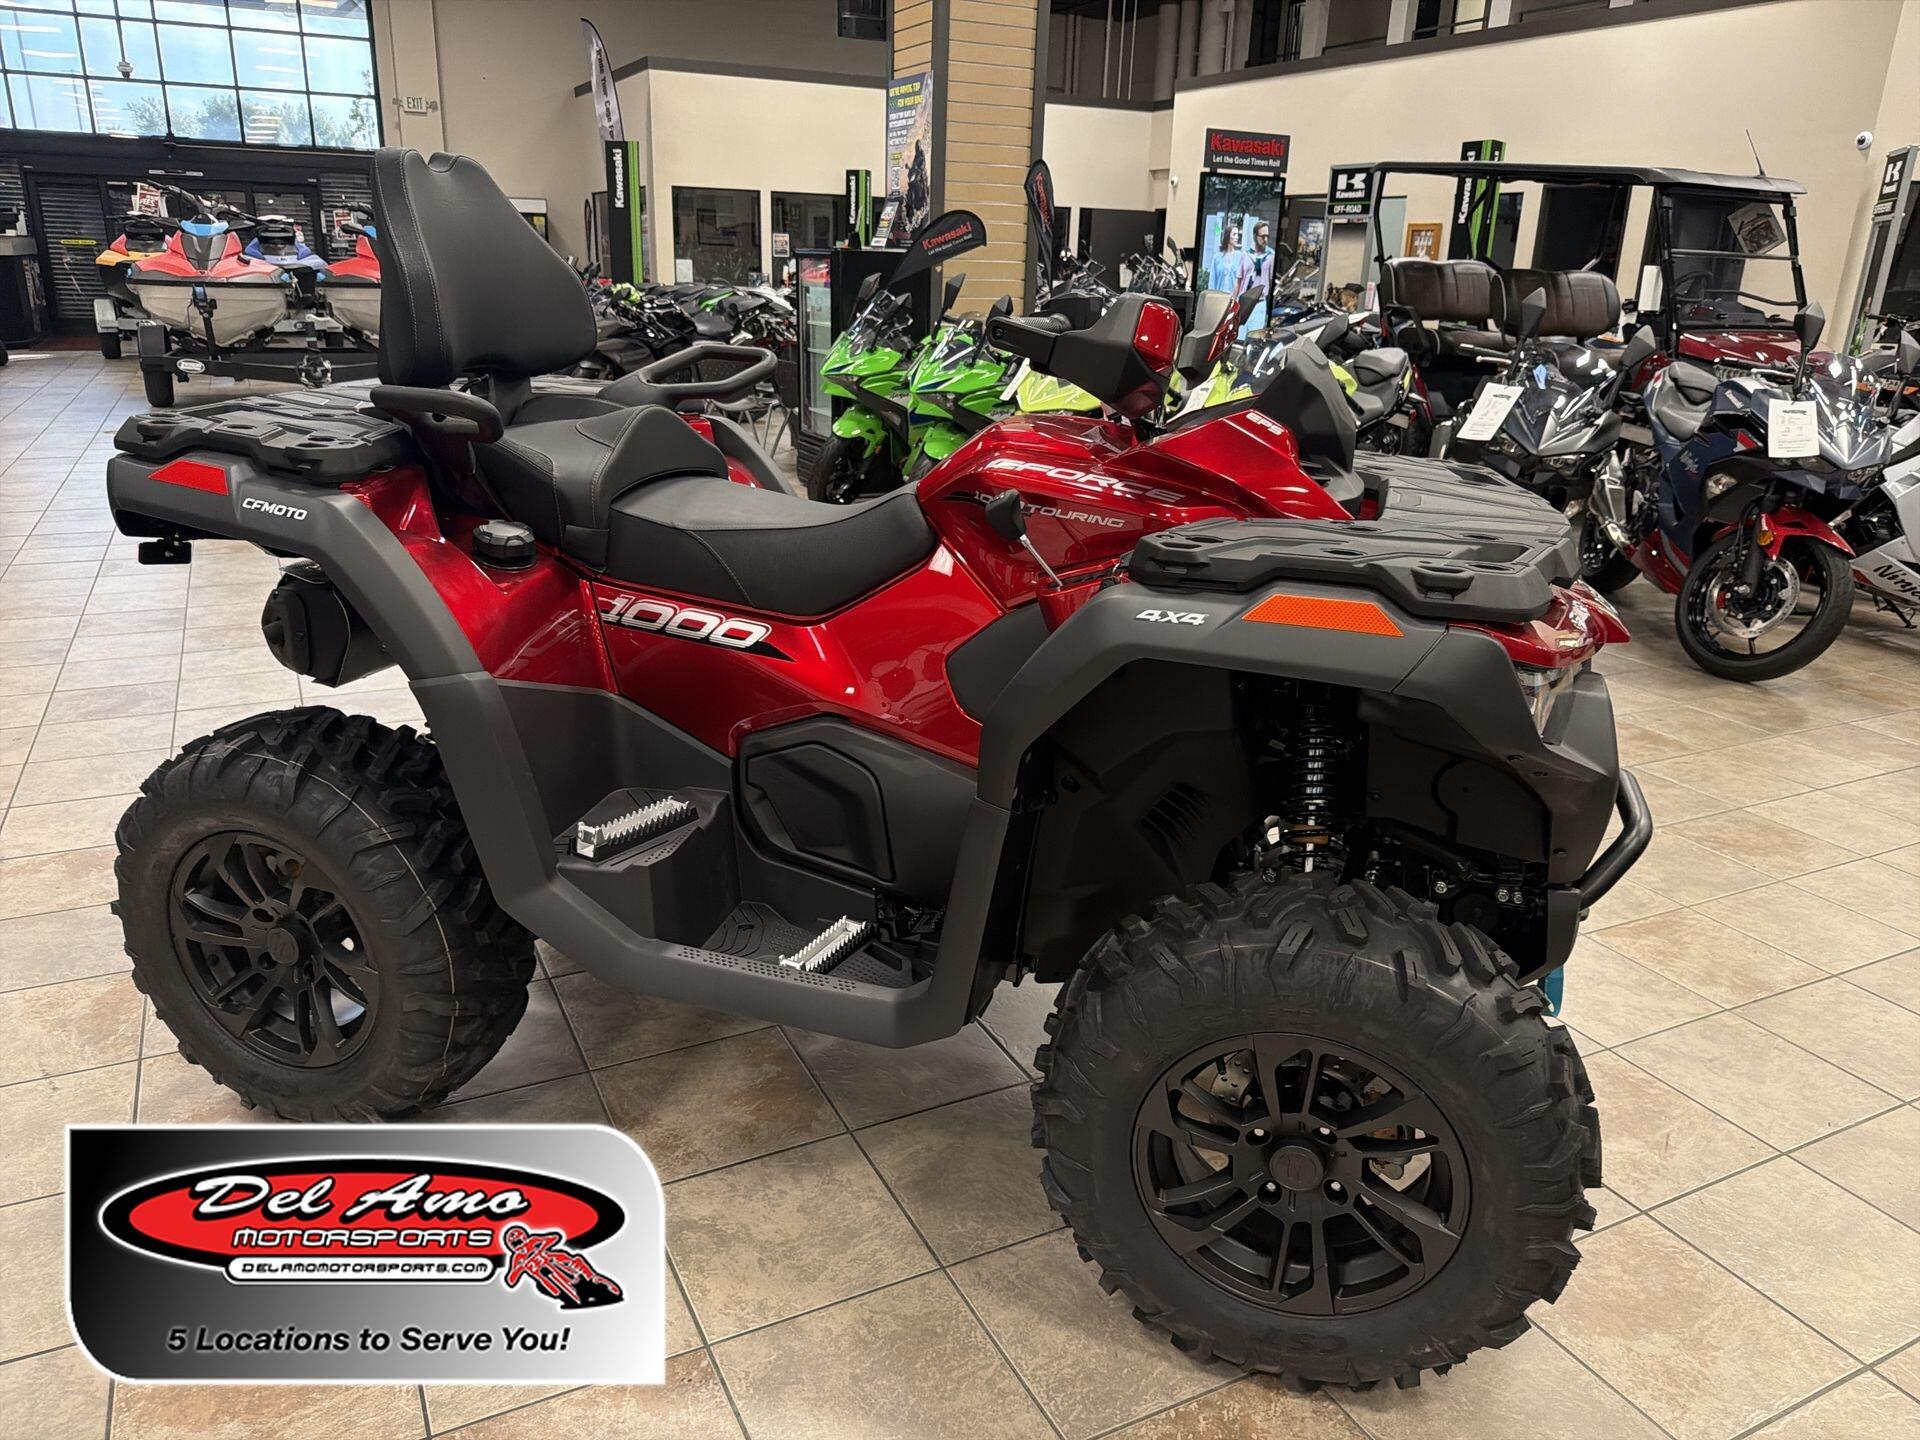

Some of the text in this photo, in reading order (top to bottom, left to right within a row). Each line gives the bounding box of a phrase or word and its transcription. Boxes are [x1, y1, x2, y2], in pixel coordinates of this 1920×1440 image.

[406, 96, 423, 110] EXIT
[1210, 133, 1285, 156] Kawasaki
[1212, 154, 1281, 167] Let the Good Times Roll
[613, 148, 625, 209] Kawasaki
[1333, 204, 1363, 214] OFF-ROAD
[922, 221, 972, 250] Kawasaki
[1245, 411, 1285, 436] EPS
[242, 497, 308, 521] CFMOTO
[1027, 503, 1126, 529] TOURING
[598, 594, 772, 649] 1000
